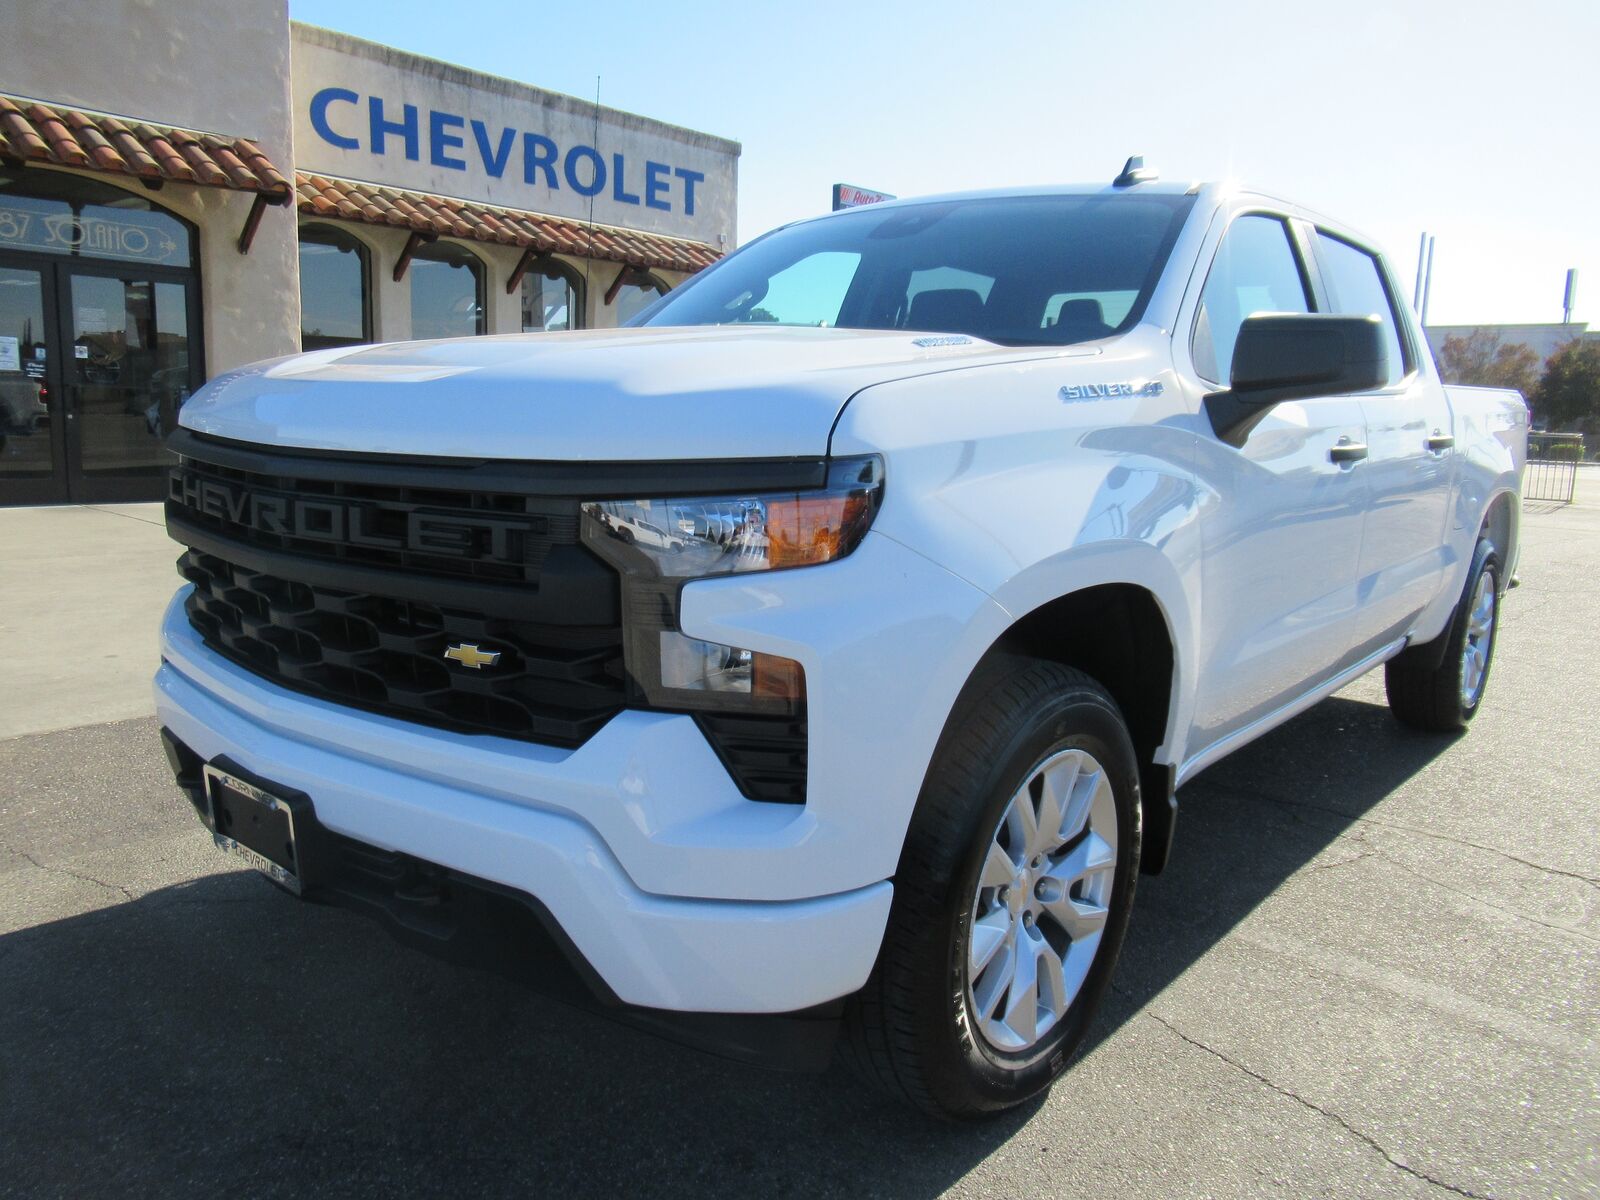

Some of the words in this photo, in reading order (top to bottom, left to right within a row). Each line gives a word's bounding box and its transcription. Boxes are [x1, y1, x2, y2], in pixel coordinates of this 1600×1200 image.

[308, 87, 705, 216] CHEVROLET
[40, 215, 149, 253] SOLANO
[1060, 381, 1164, 400] SILVER
[168, 470, 535, 562] CHEVROLET
